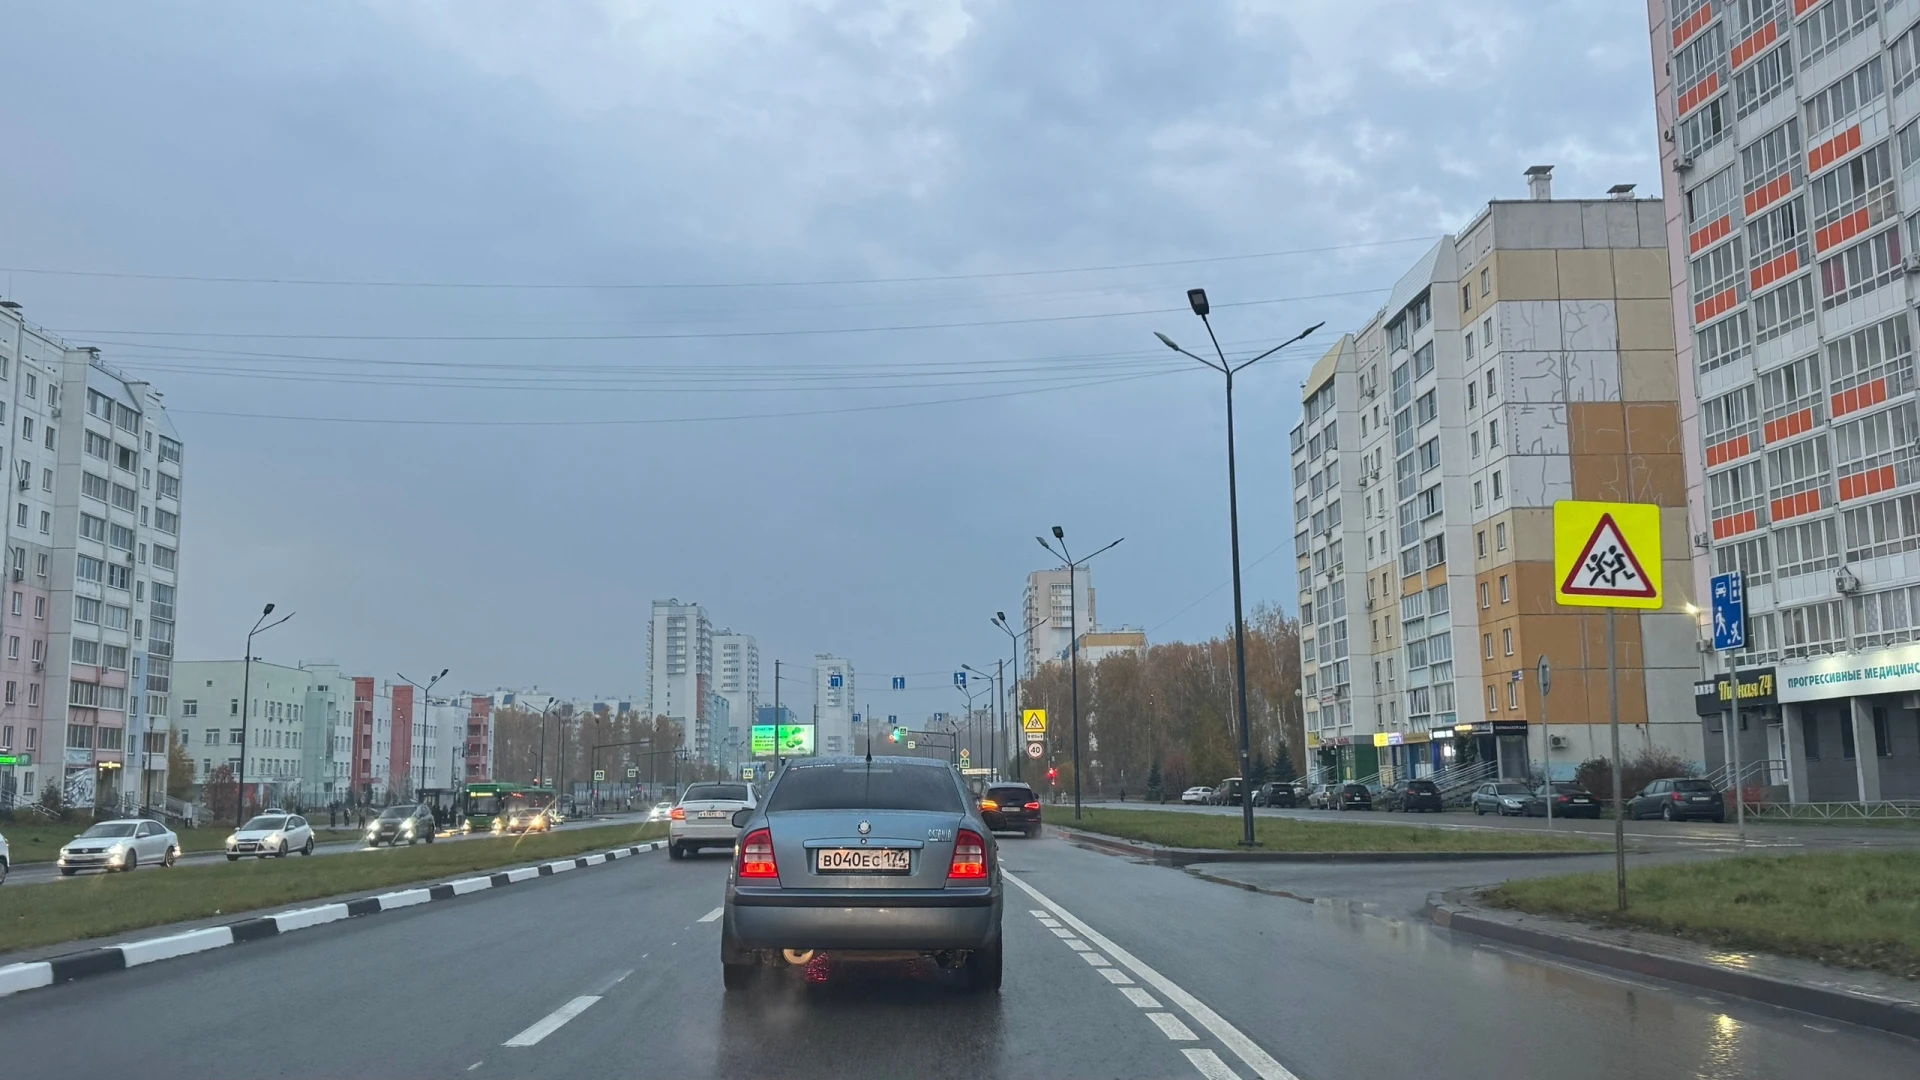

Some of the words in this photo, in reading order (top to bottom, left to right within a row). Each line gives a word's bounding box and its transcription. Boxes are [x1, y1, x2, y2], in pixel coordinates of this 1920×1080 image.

[1759, 674, 1773, 696] 74
[1788, 669, 1862, 688] ПРОГРЕССИВНЫЕ
[1030, 745, 1041, 754] 40
